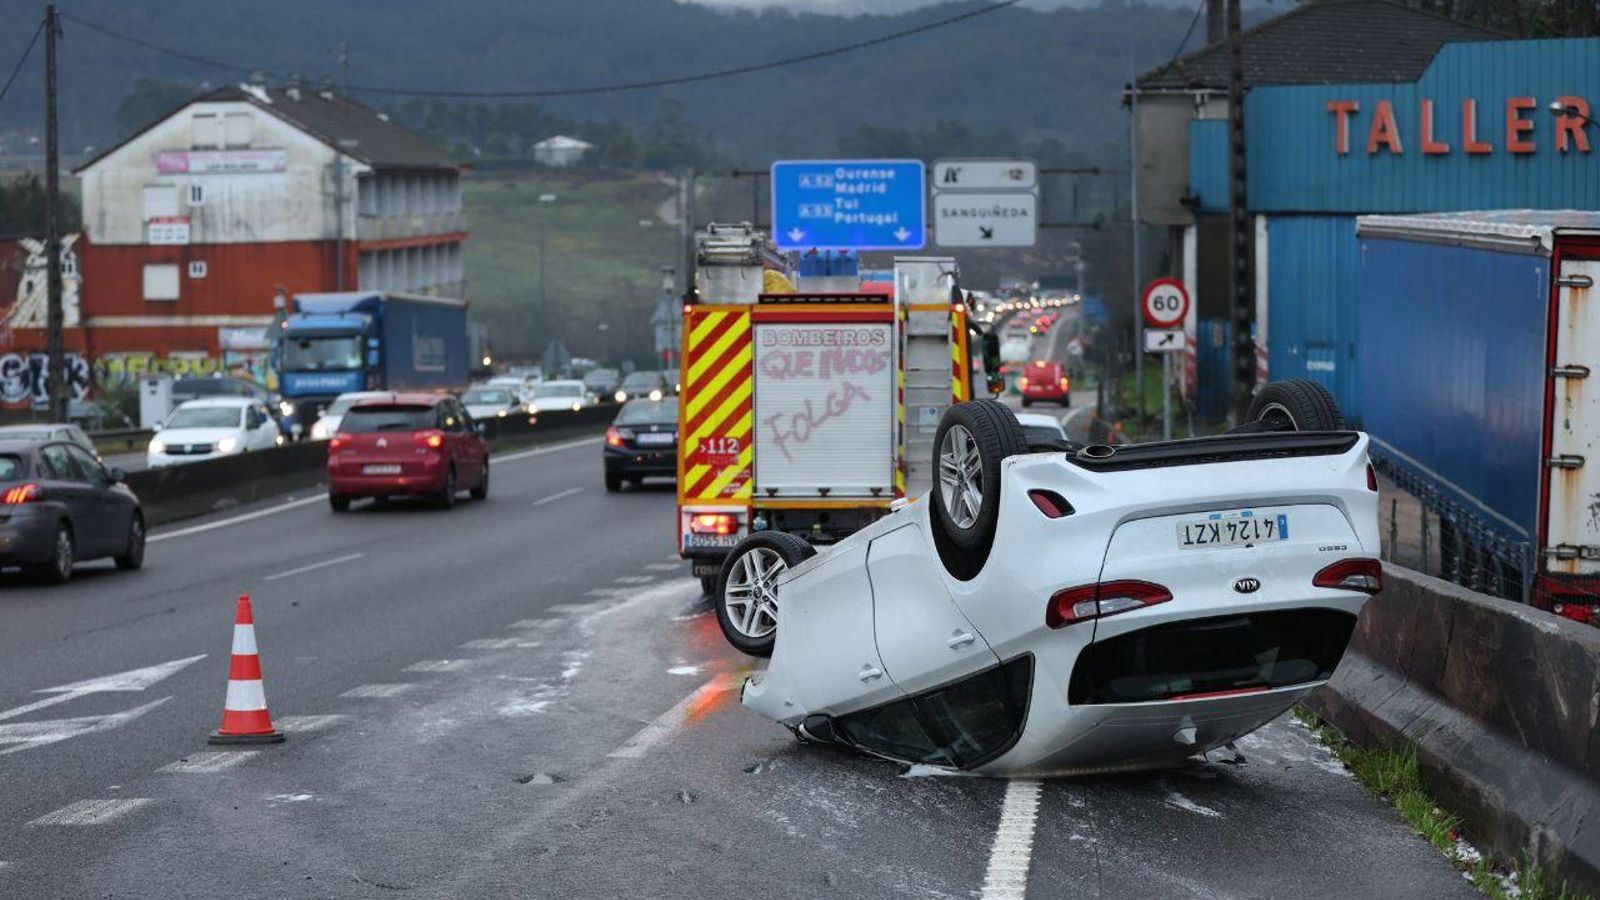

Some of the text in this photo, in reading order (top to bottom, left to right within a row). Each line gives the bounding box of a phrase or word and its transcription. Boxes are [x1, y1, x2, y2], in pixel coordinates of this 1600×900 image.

[1327, 96, 1590, 154] TALLER
[834, 167, 895, 179] Ourense
[834, 182, 887, 194] Madrid
[835, 198, 859, 209] Tui
[834, 213, 897, 226] Portugal
[942, 207, 1028, 218] SANGUIÑEDA
[1153, 295, 1180, 311] 60
[763, 329, 884, 346] BOMBEIROS
[764, 381, 873, 464] FOLGA
[706, 438, 739, 454] 112
[1183, 518, 1274, 545] 4124 KZT
[1237, 579, 1259, 590] KIA
